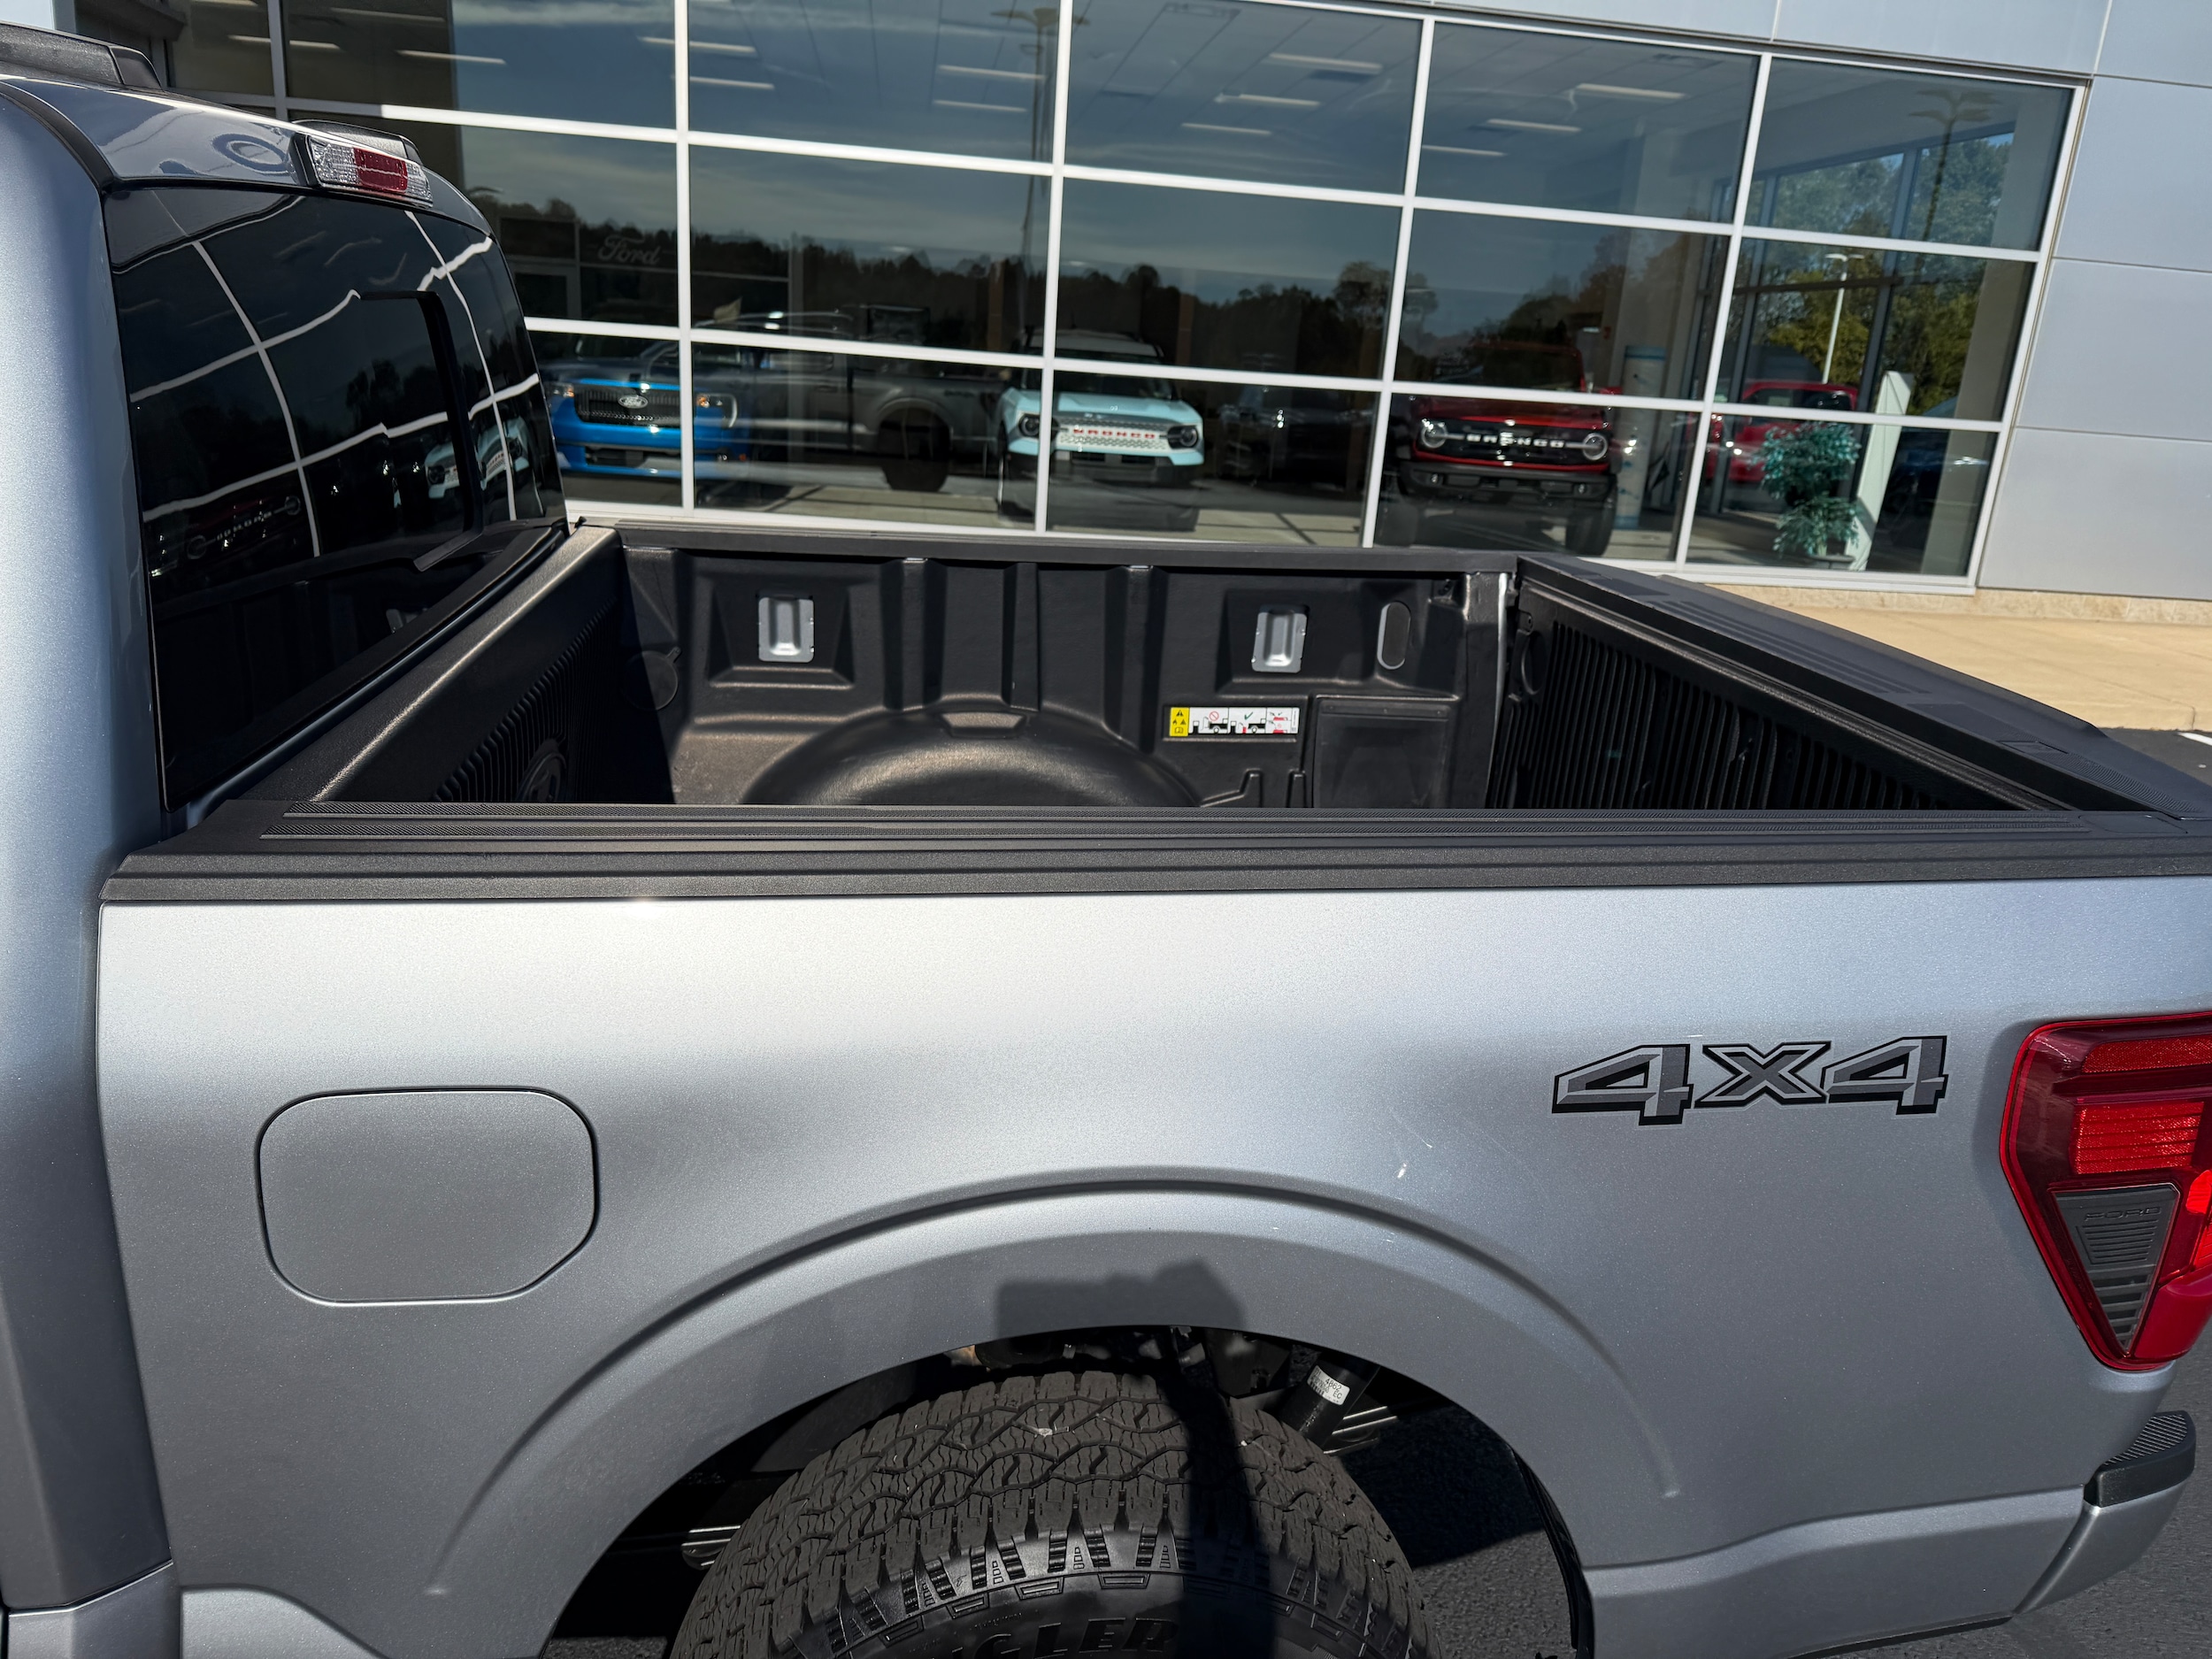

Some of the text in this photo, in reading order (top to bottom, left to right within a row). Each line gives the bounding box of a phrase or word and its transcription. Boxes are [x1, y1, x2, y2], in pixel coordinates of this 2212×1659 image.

[598, 234, 661, 265] Ford
[1072, 428, 1155, 439] BRONCO
[1466, 433, 1565, 449] BRONCO
[2085, 1207, 2162, 1222] FORD
